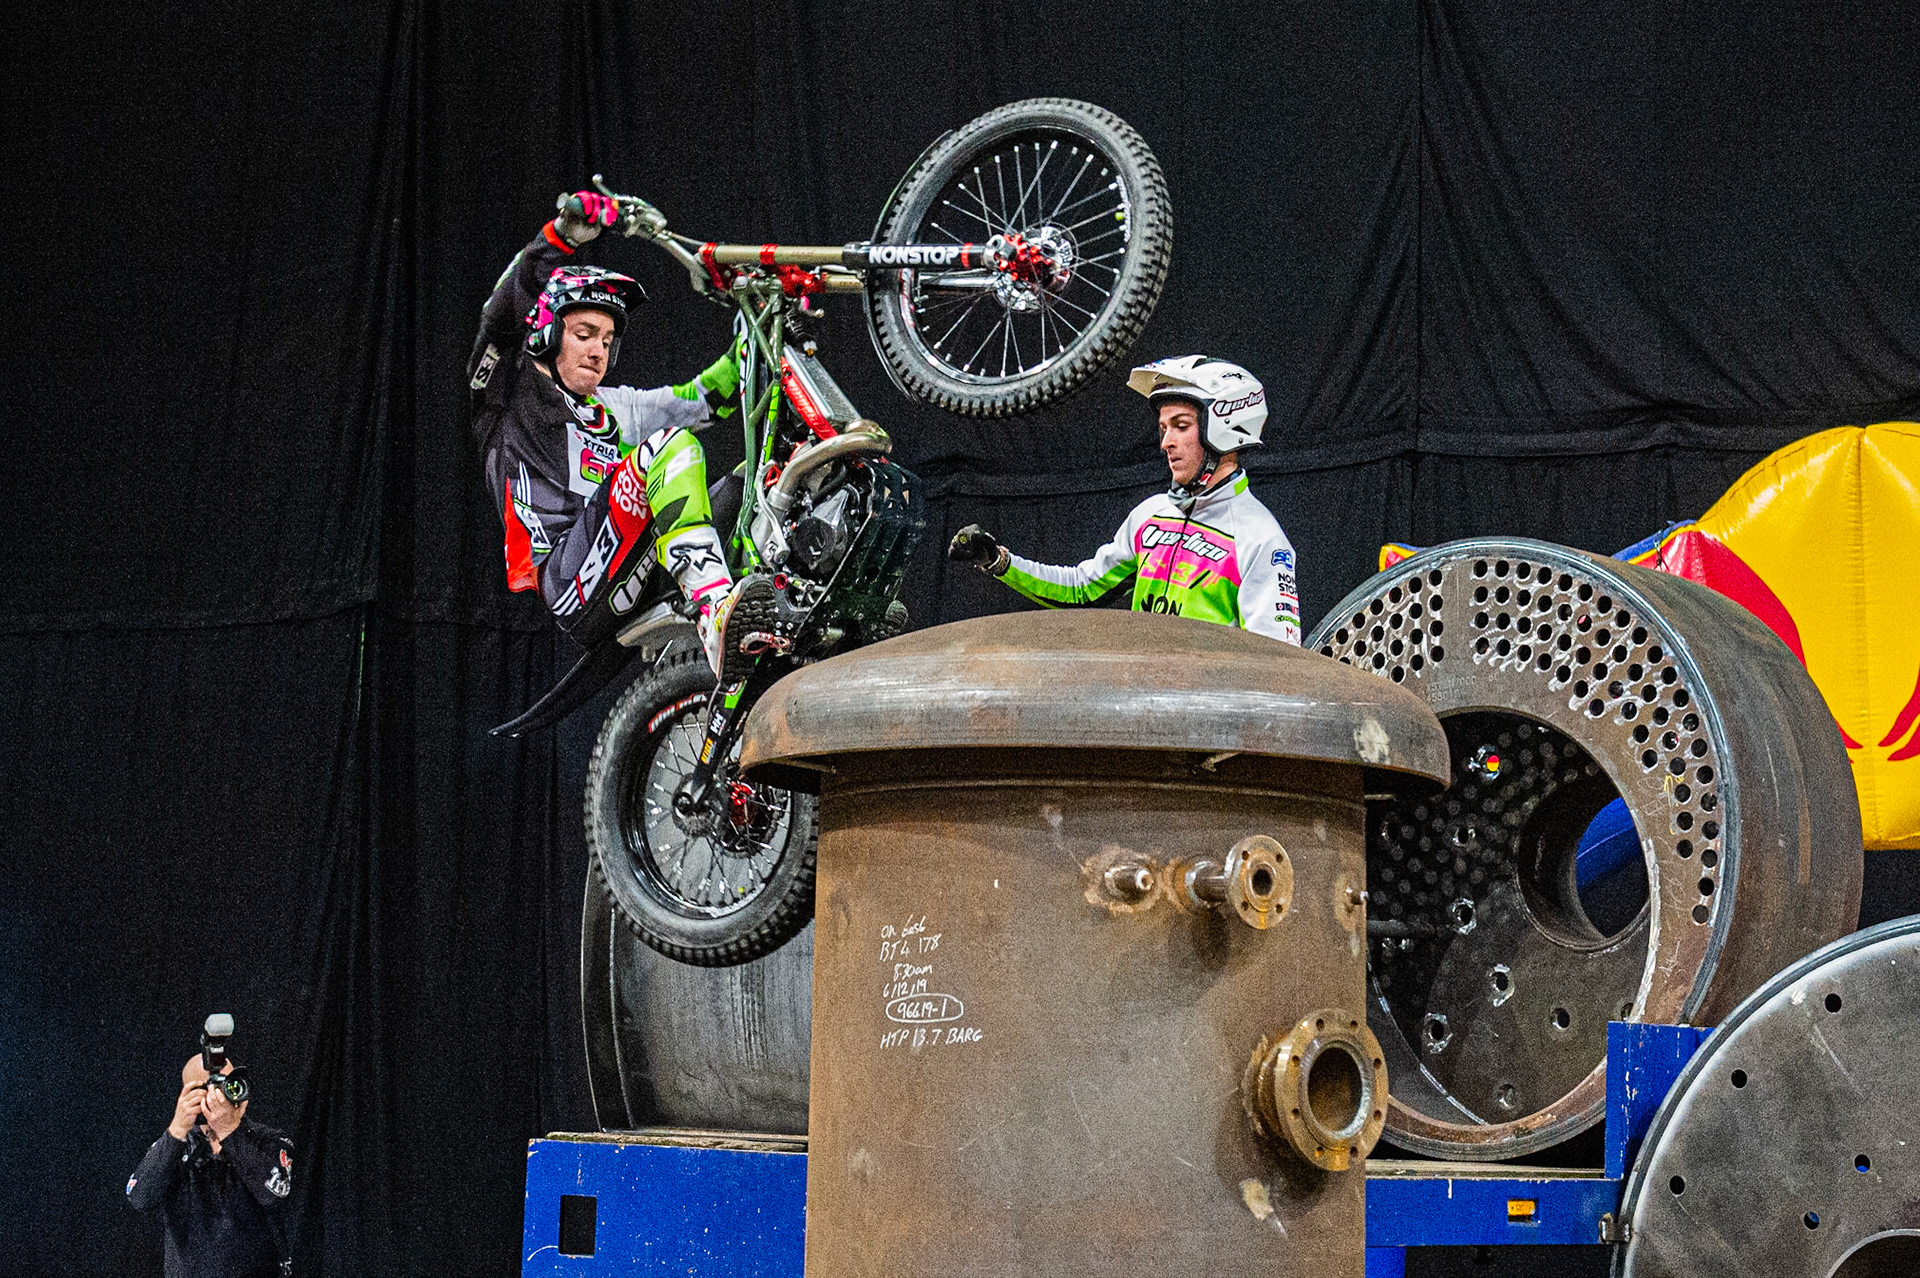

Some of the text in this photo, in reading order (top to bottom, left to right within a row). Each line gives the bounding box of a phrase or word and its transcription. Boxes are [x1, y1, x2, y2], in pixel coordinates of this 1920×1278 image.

[868, 245, 960, 265] NONSTOP
[591, 290, 611, 302] NON
[611, 480, 648, 520] NON
[1140, 523, 1229, 563] Vertigo
[919, 933, 942, 953] 178
[880, 1025, 983, 1049] HTP 13.7 BARG
